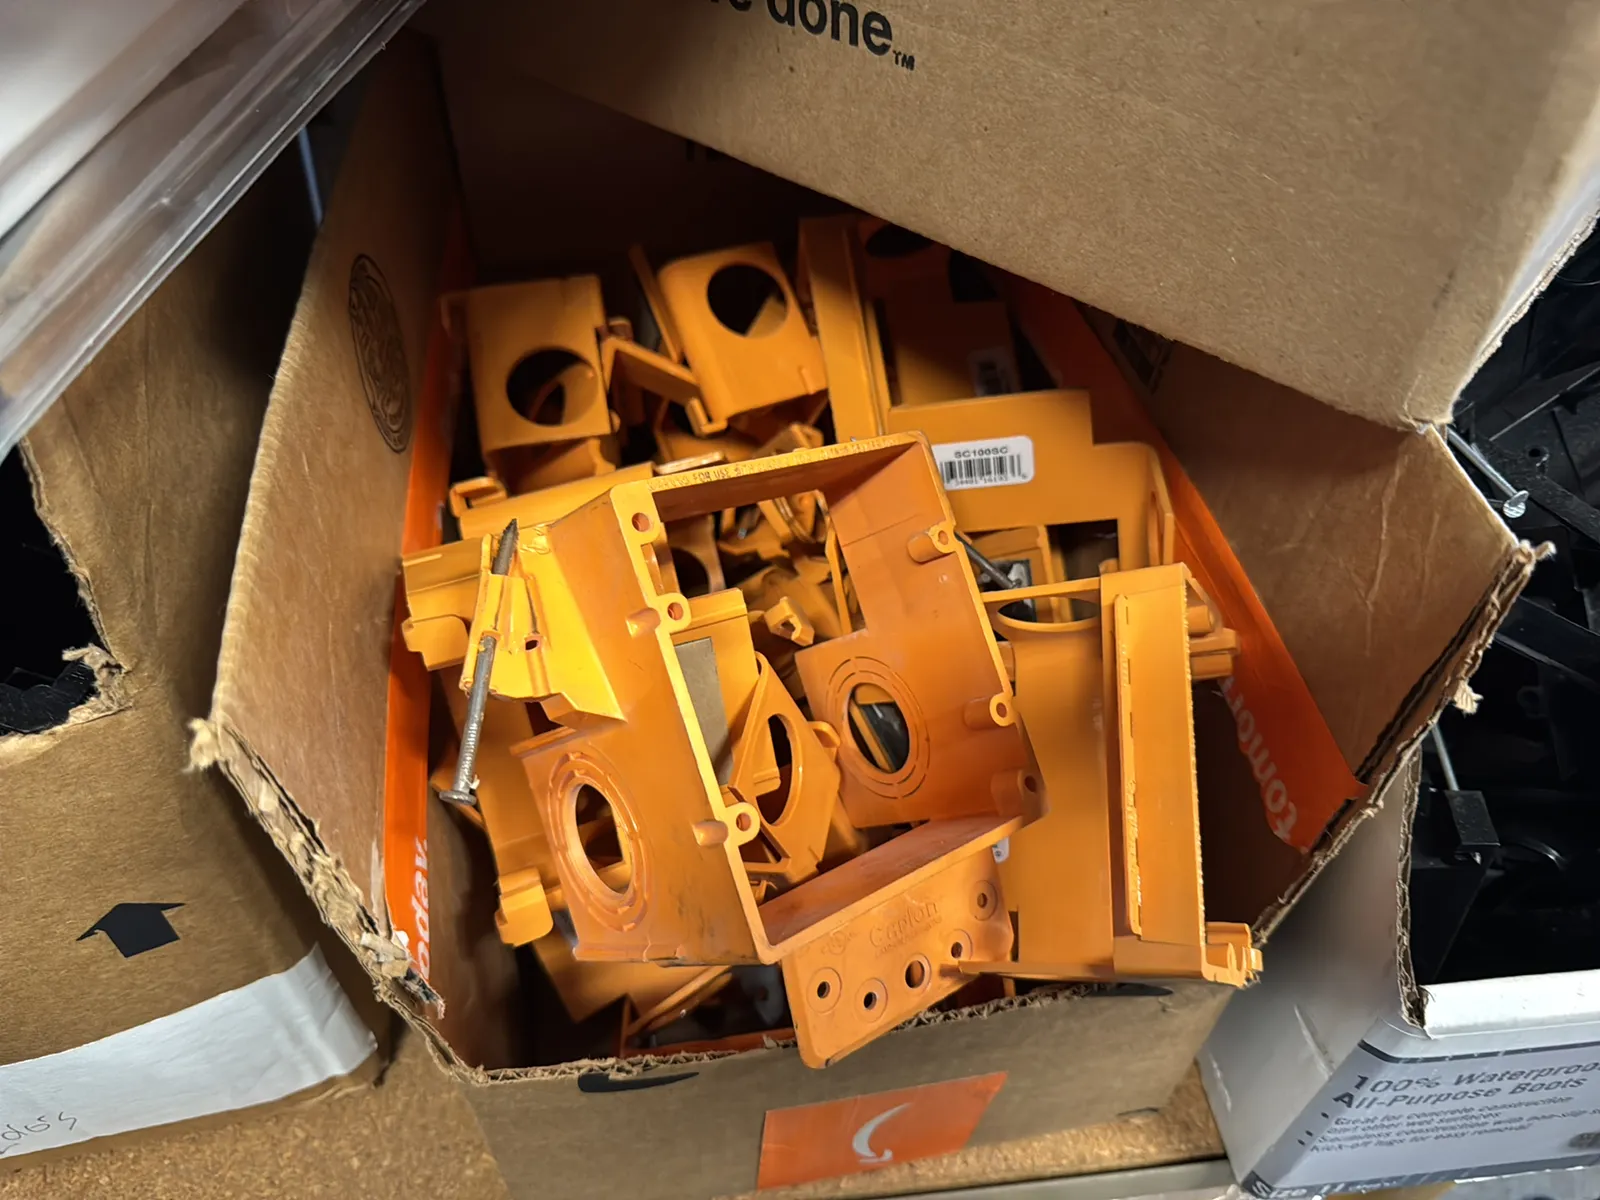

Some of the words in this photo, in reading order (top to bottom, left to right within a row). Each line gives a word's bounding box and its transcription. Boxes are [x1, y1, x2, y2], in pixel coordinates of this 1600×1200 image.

[954, 446, 1009, 459] SC100SC
[411, 836, 430, 980] oday
[869, 902, 939, 948] Carlon
[1333, 1087, 1502, 1109] All-Purpose
[1508, 1076, 1588, 1095] Boots
[1353, 1074, 1442, 1093] 100%
[1453, 1060, 1600, 1087] Waterproo
